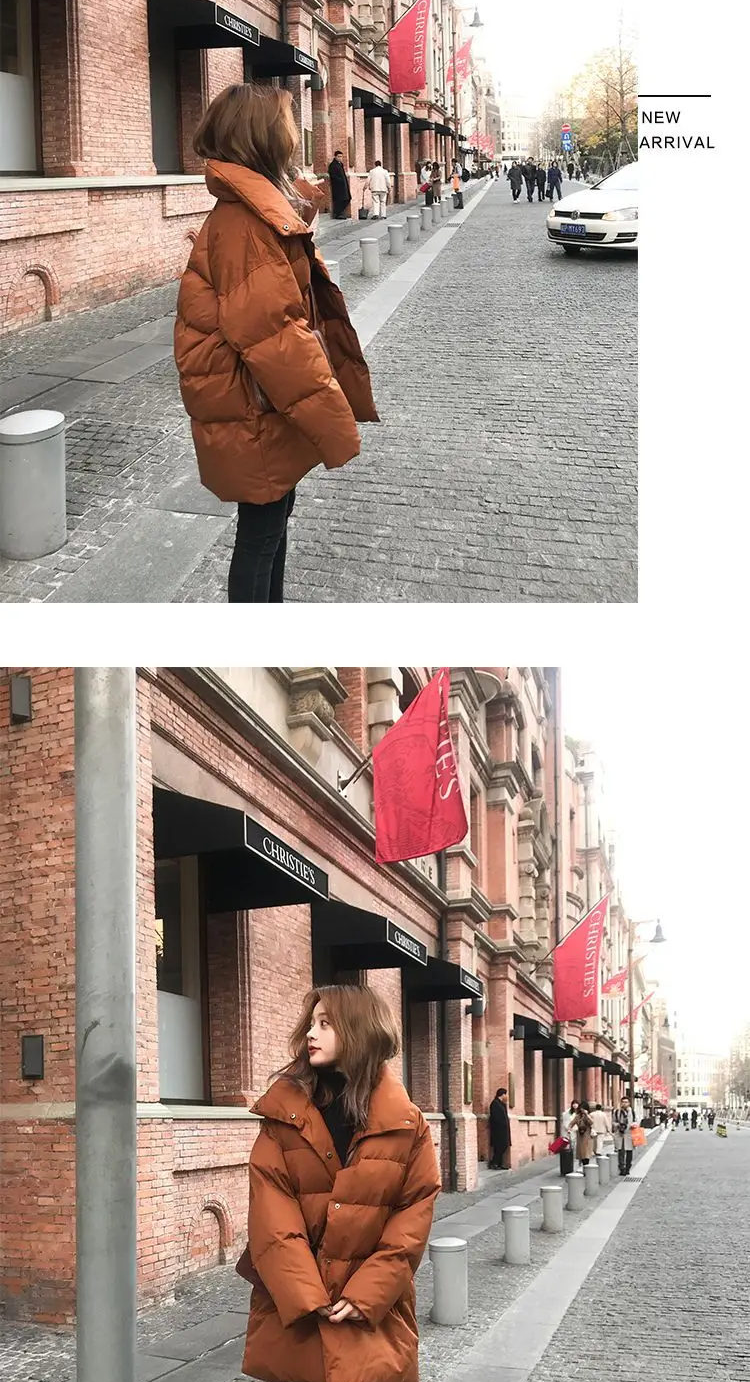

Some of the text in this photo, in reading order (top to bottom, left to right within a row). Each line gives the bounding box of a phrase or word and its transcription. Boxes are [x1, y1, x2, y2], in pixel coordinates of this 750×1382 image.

[413, 0, 428, 74] CHRISTIE'S
[262, 836, 316, 885] CHRISTIE'S
[583, 910, 601, 998] CHRISTIE'S
